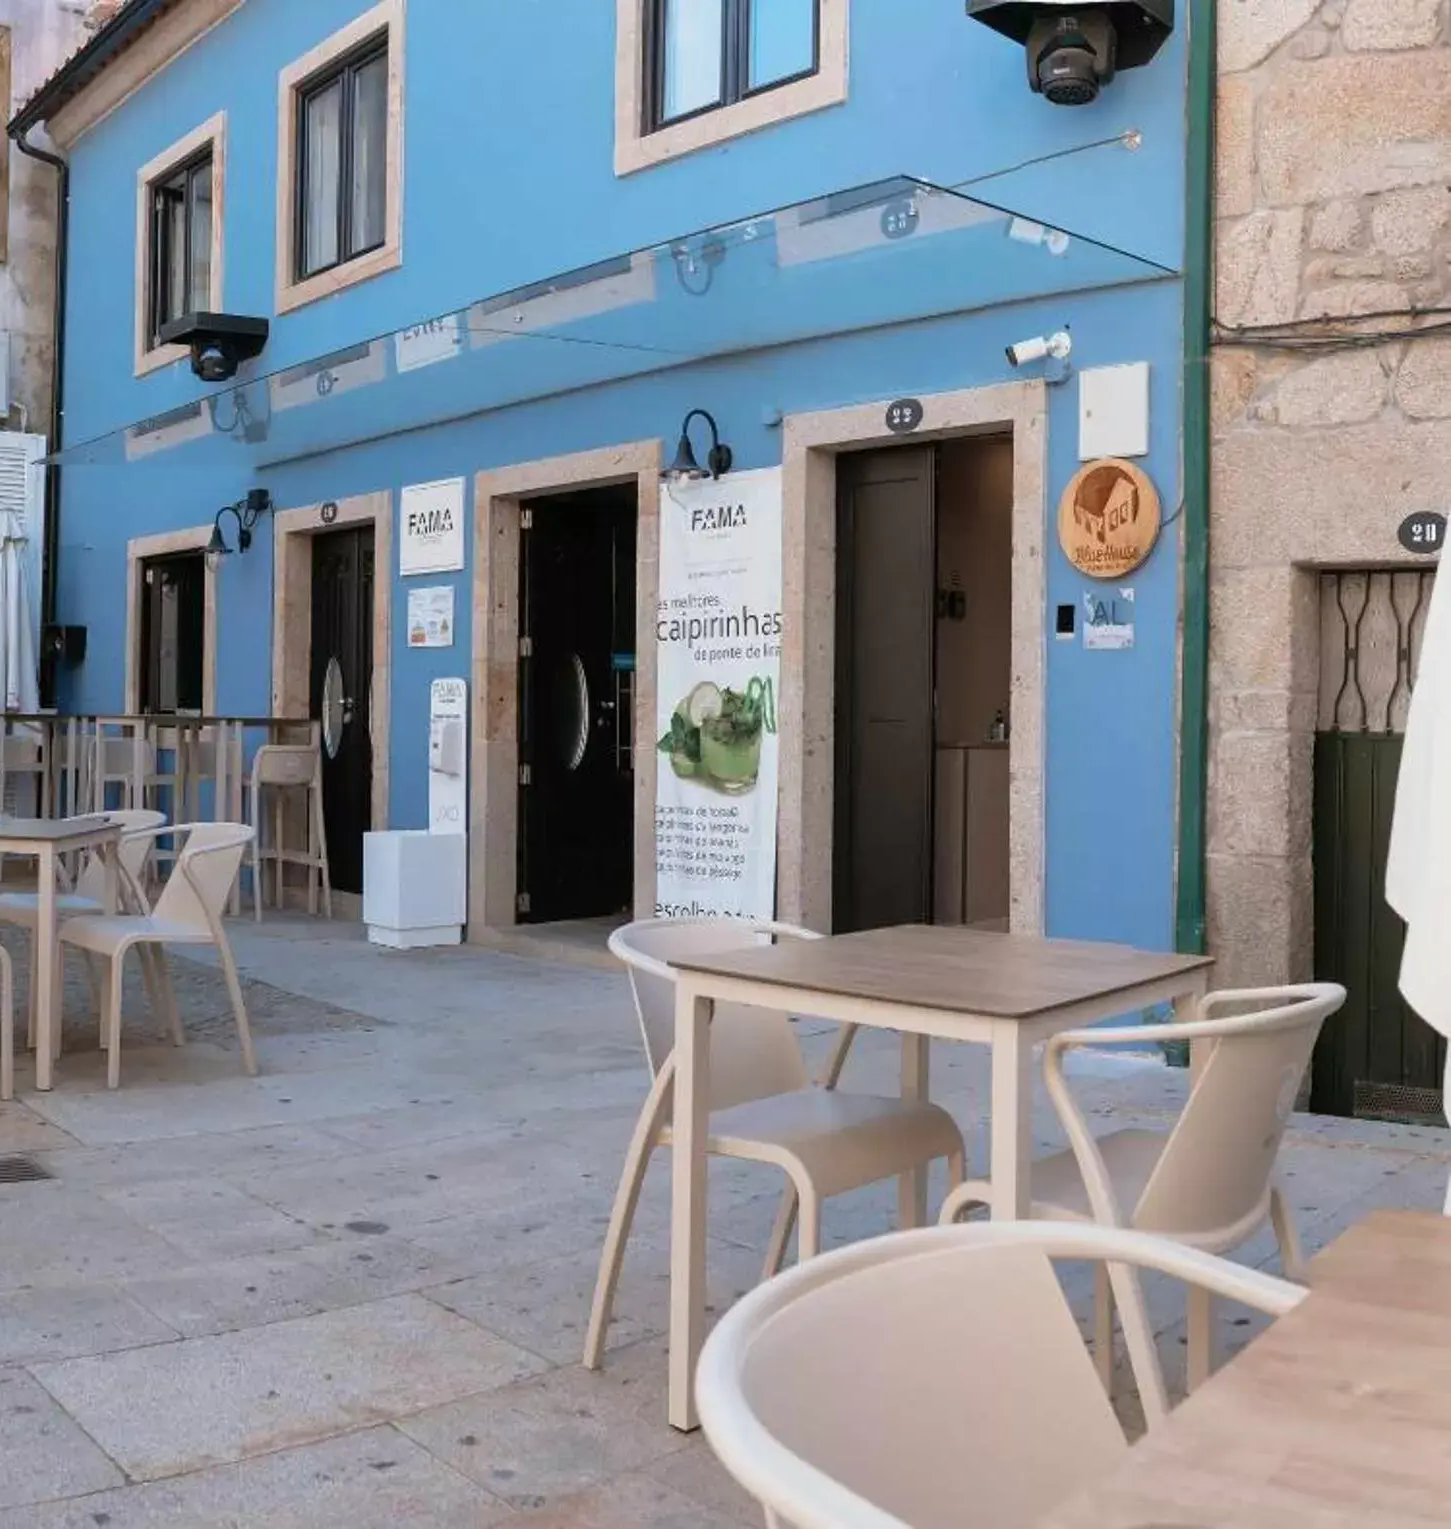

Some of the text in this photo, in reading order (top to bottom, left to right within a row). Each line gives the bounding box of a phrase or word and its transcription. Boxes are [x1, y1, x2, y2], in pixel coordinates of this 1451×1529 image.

[408, 507, 454, 536] FAMA
[691, 504, 747, 531] FAMA
[656, 606, 783, 649] caipirinhas
[709, 647, 742, 665] ponte
